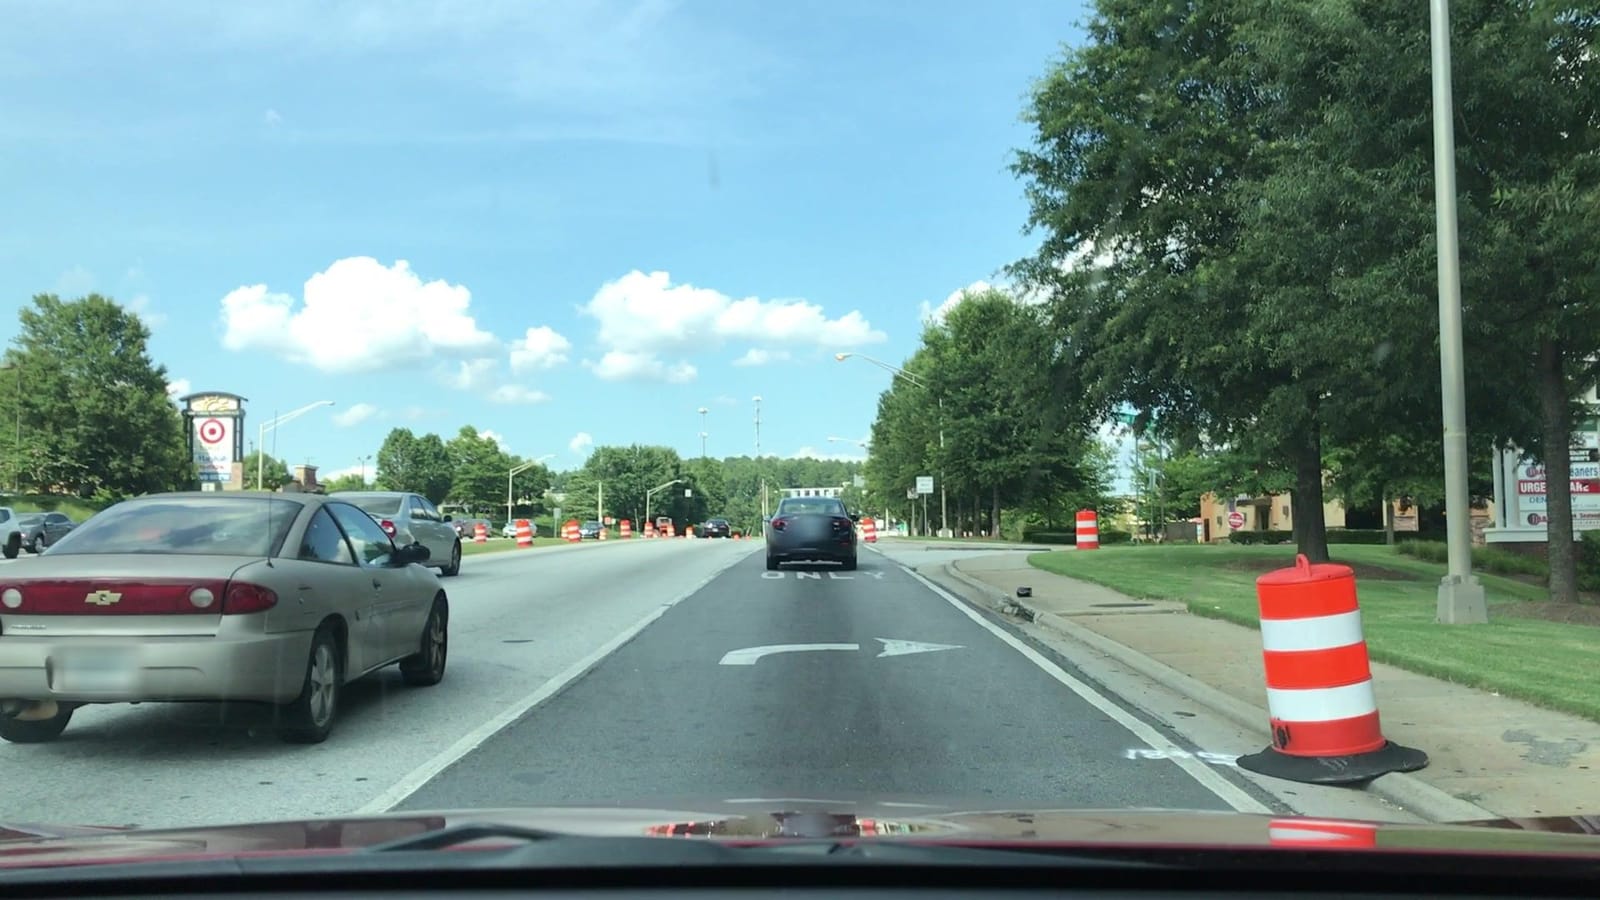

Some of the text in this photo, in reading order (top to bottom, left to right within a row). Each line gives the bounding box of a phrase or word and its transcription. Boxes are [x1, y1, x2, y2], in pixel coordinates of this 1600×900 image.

[1570, 467, 1598, 477] eaners
[1520, 482, 1589, 493] URGE ARE
[761, 571, 885, 580] ONLY
